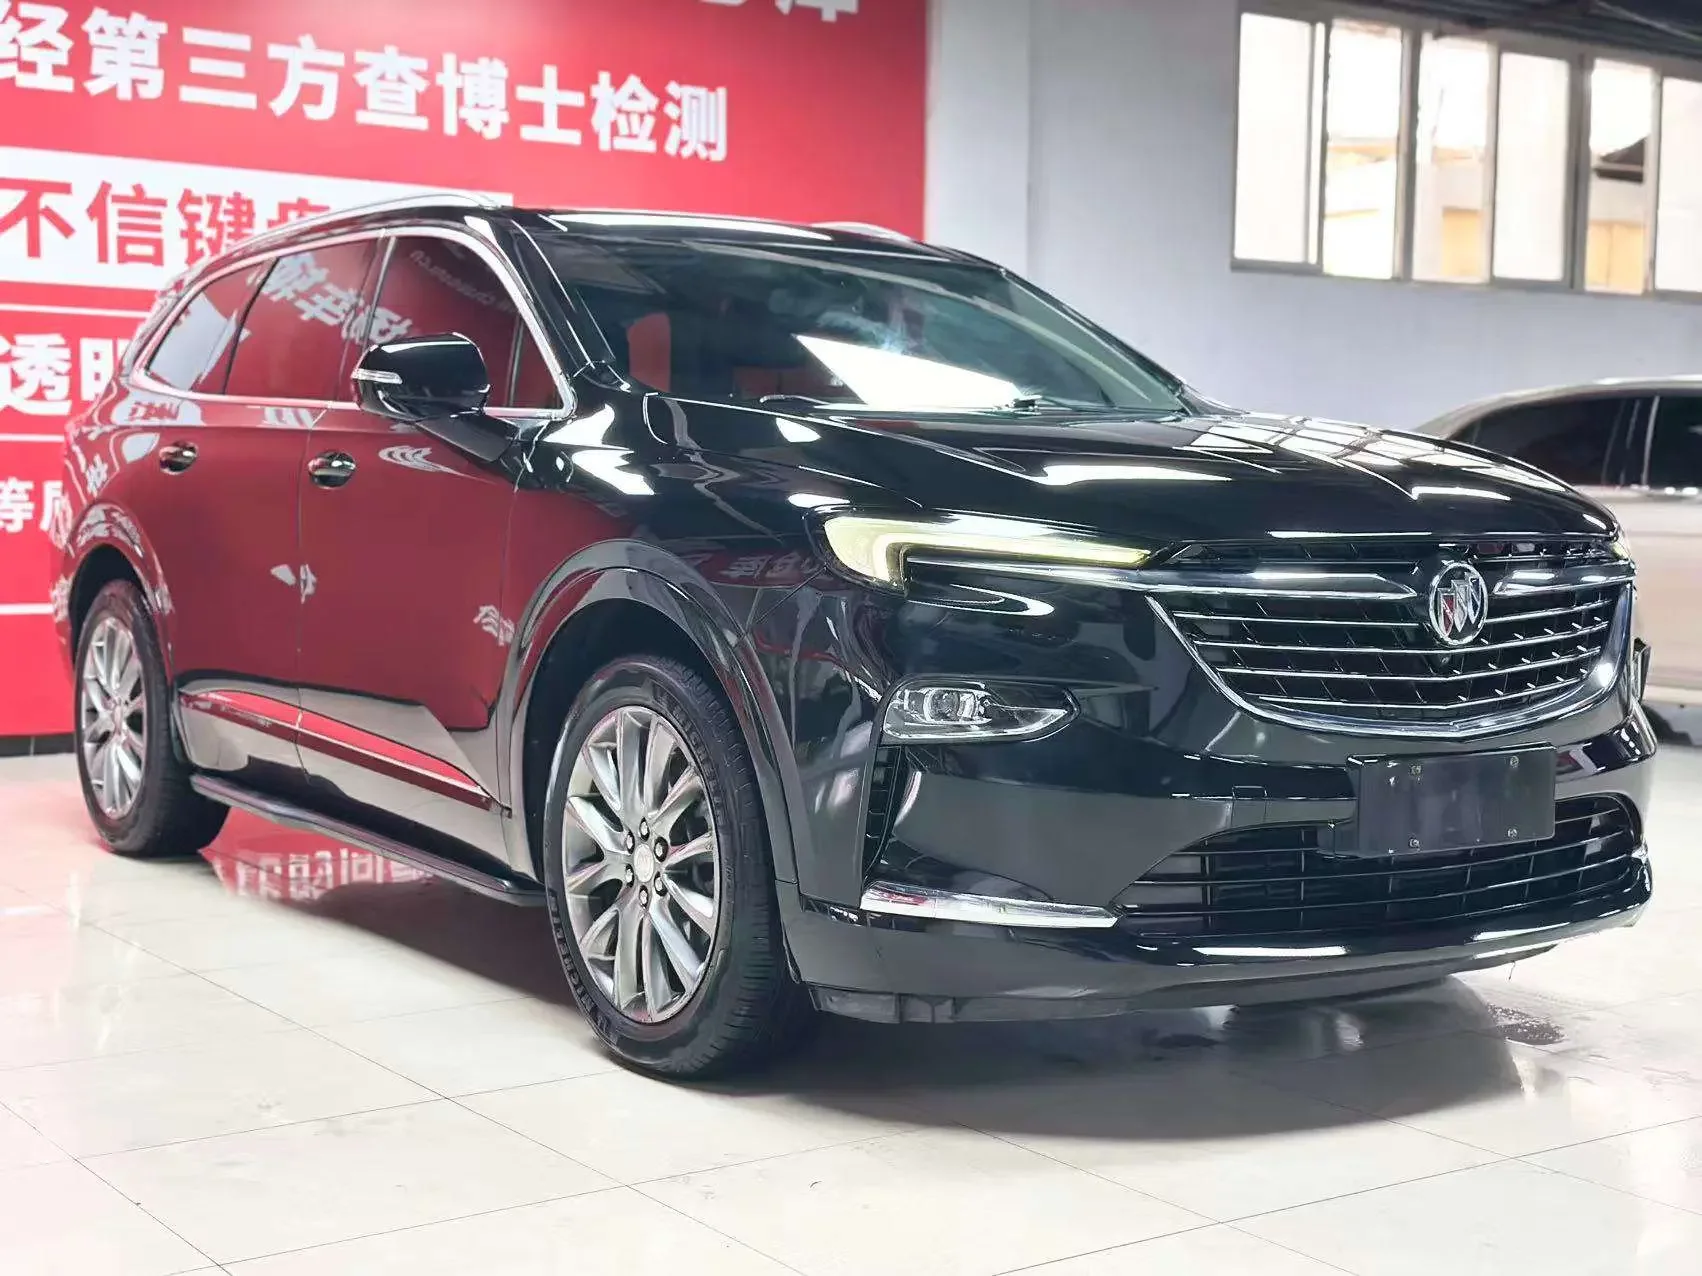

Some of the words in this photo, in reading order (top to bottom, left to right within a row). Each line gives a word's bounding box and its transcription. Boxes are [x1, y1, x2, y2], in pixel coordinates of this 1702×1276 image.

[0, 2, 728, 162] 经第三方查博士检测
